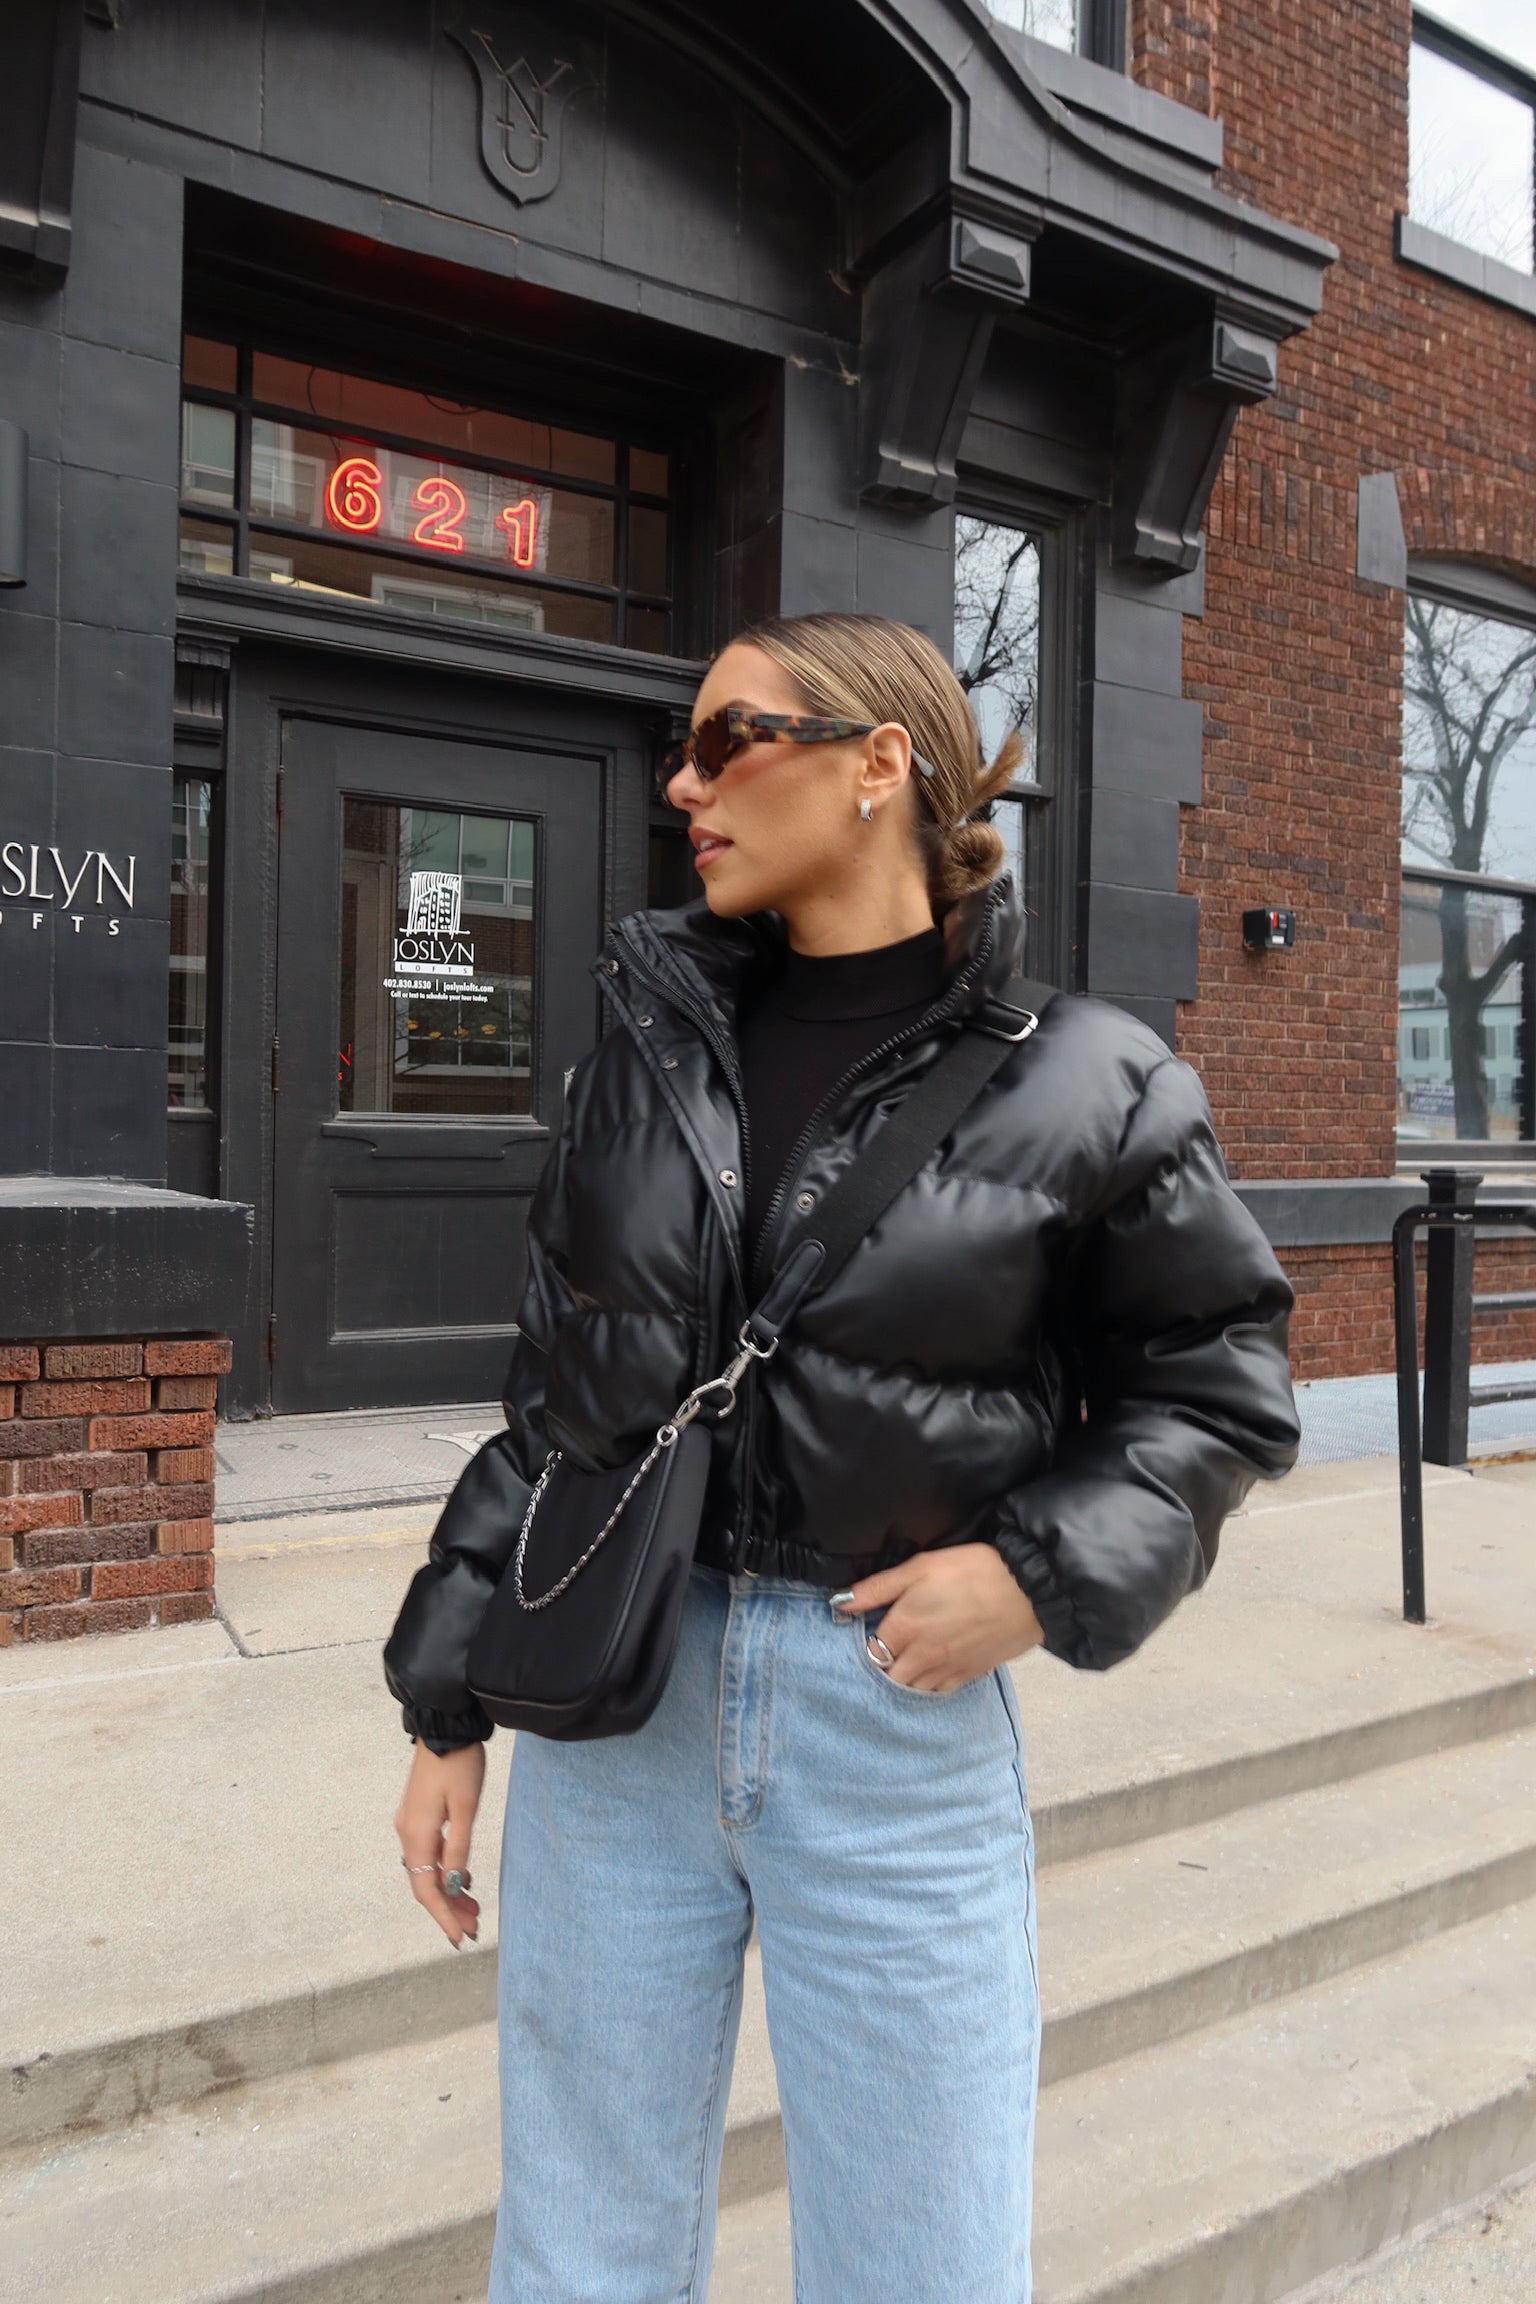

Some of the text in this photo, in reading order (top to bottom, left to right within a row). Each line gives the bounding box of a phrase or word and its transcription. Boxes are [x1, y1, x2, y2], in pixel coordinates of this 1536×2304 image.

[328, 457, 538, 567] 621
[0, 911, 120, 936] FTS
[393, 938, 475, 964] JOSLYN
[399, 964, 468, 974] LOFTS
[383, 978, 494, 993] 402.830.8530 joslynlofts.com
